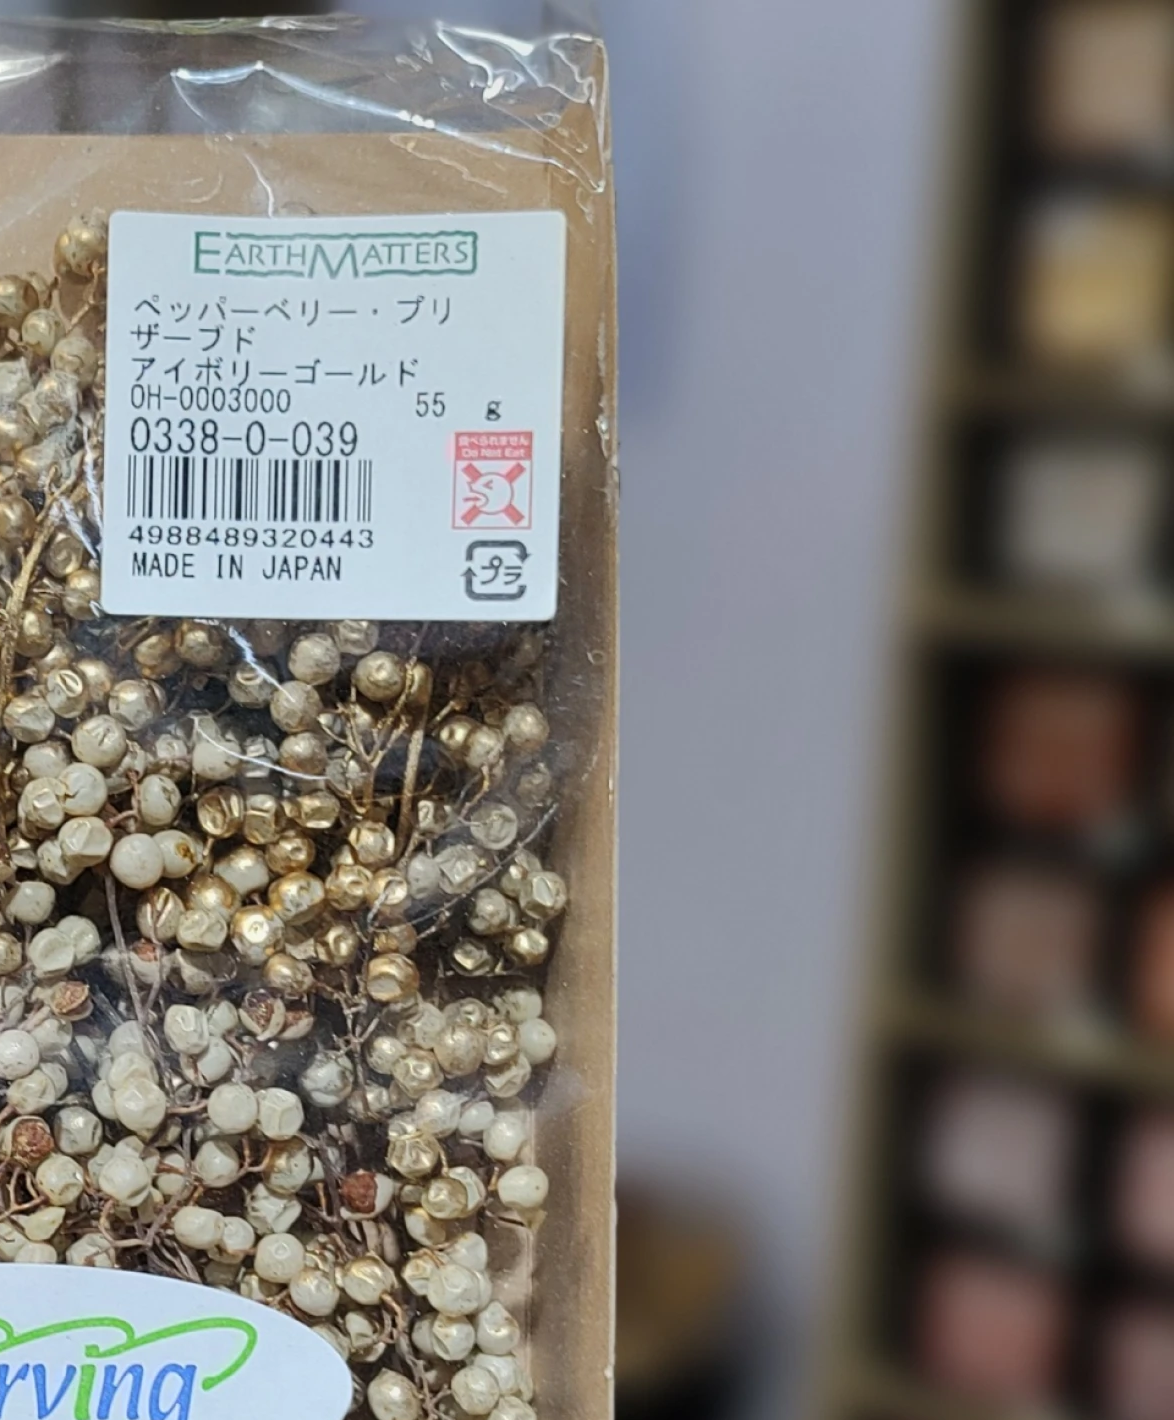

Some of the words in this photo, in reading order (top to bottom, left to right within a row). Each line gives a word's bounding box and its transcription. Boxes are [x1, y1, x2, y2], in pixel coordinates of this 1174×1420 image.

[130, 324, 257, 353] ザーブド
[131, 356, 420, 388] アイボリーゴールド
[415, 392, 446, 418] 55
[484, 399, 502, 421] g
[130, 417, 359, 457] 0338-0-039
[128, 524, 375, 549] 4988489320443
[132, 552, 196, 579] MADE
[216, 554, 244, 580] IN
[262, 555, 342, 581] JAPAN
